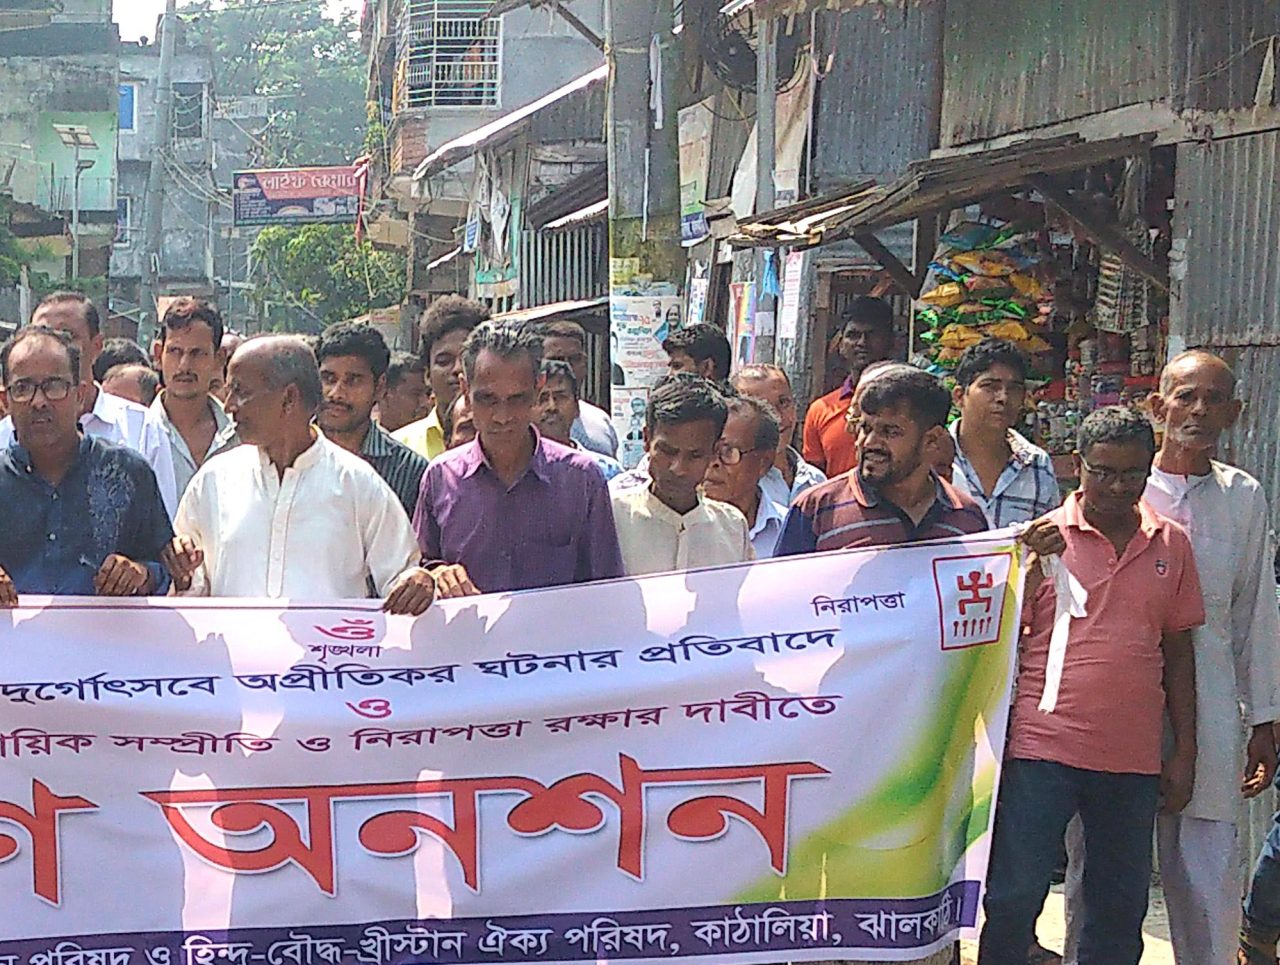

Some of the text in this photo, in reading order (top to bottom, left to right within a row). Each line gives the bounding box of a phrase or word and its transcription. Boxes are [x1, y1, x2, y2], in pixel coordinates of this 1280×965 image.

[810, 591, 906, 617] নিরাপত্তা
[233, 663, 462, 694] অপ্রীতিকর
[473, 646, 625, 680] ঘটনার
[636, 623, 839, 667] প্রতিবাদে
[108, 731, 281, 757] সম্প্রীতি
[296, 735, 331, 753] ও
[351, 716, 525, 754] নিরাপত্তা
[545, 705, 668, 735] রক্ষার
[681, 688, 843, 726] দাবীতে
[345, 699, 392, 718] ও
[137, 751, 832, 899] অনশন
[477, 918, 550, 957] ঐক্য
[563, 916, 679, 958] পরিষদ,
[691, 905, 841, 949] কাঠালিয়া,
